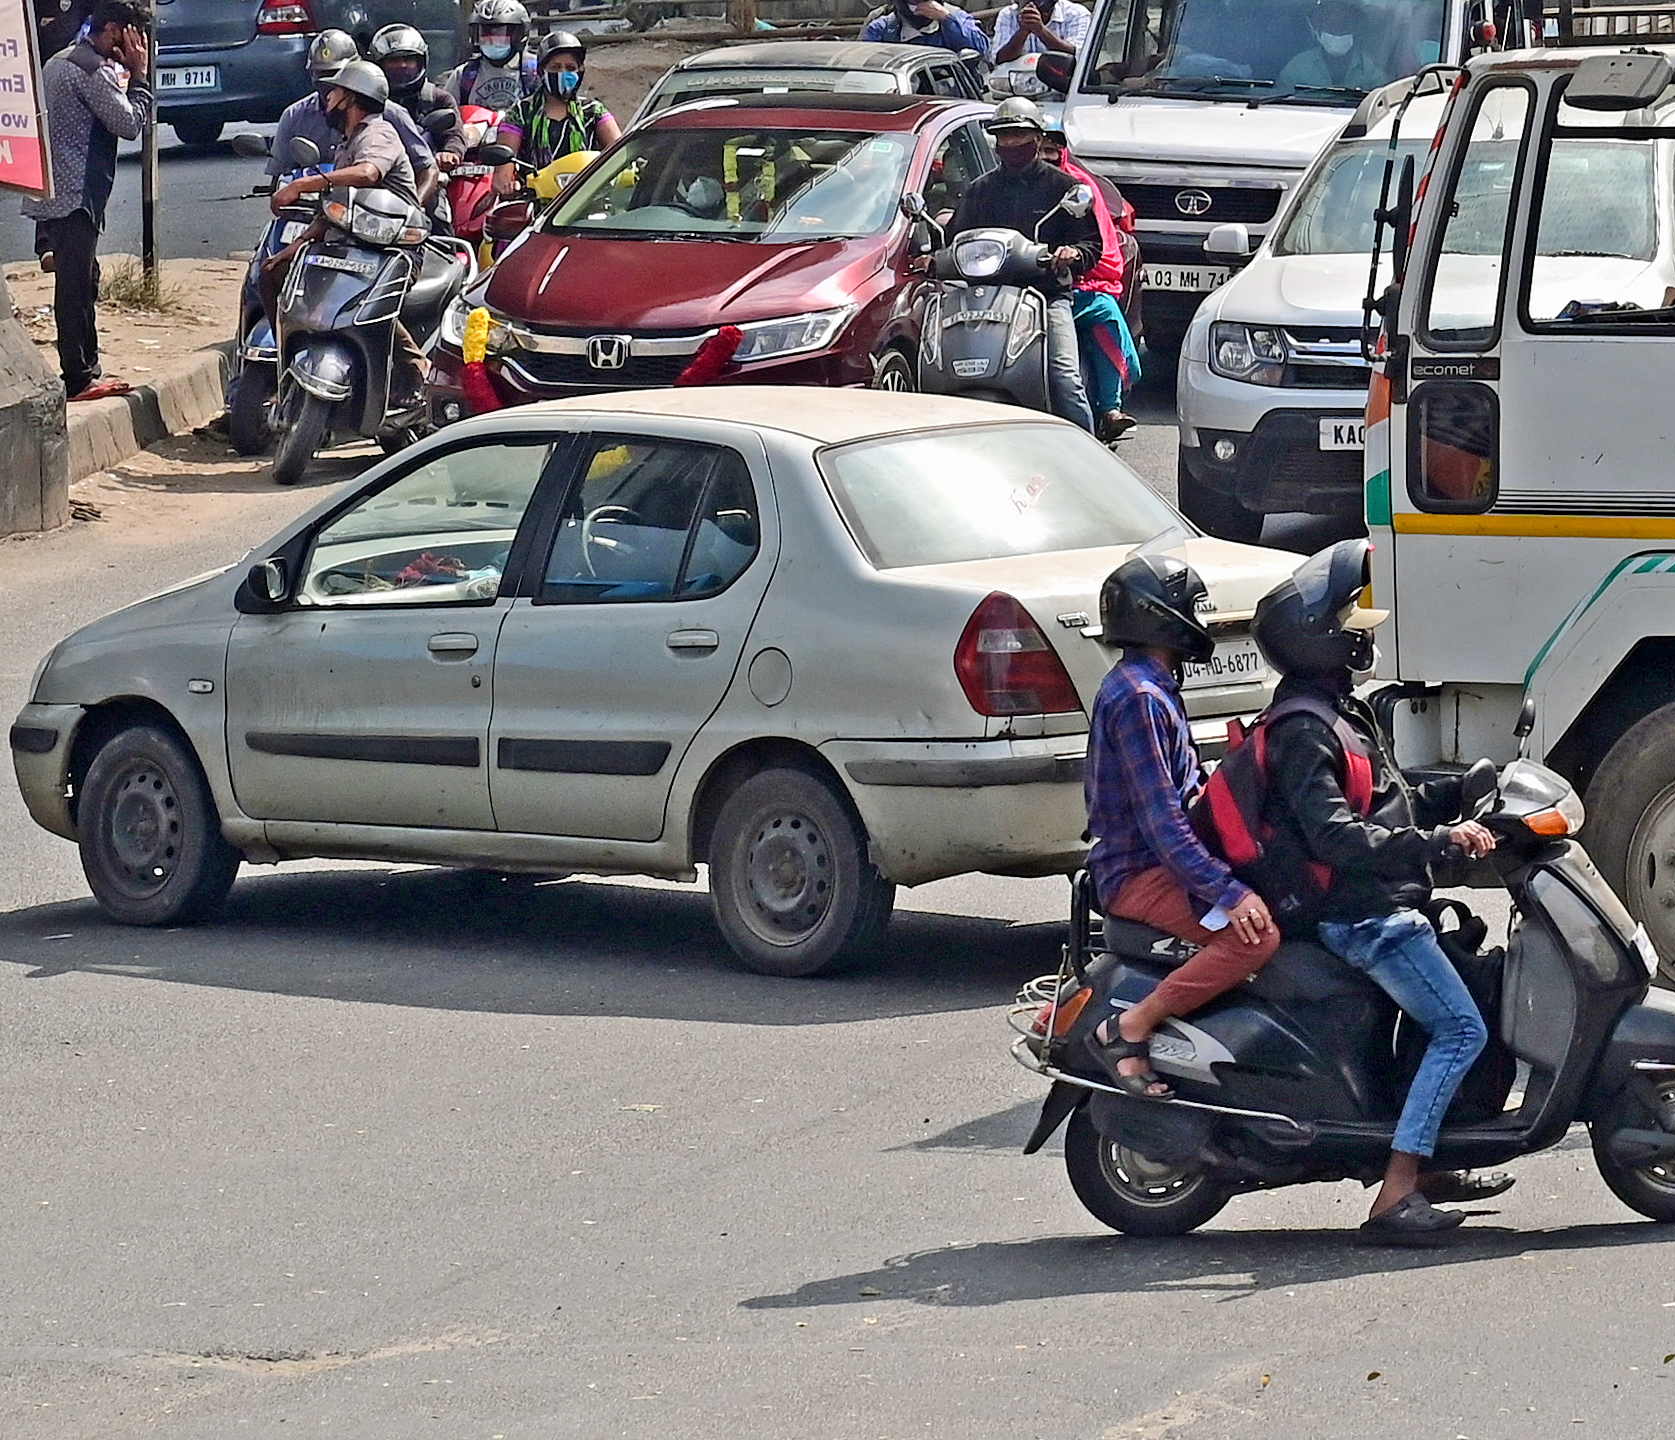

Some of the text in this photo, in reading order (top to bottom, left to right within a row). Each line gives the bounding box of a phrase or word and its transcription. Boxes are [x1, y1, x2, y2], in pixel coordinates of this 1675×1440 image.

[184, 70, 212, 84] 9714
[1155, 273, 1172, 287] 03
[1180, 274, 1200, 288] MH
[1412, 362, 1476, 376] ecomet
